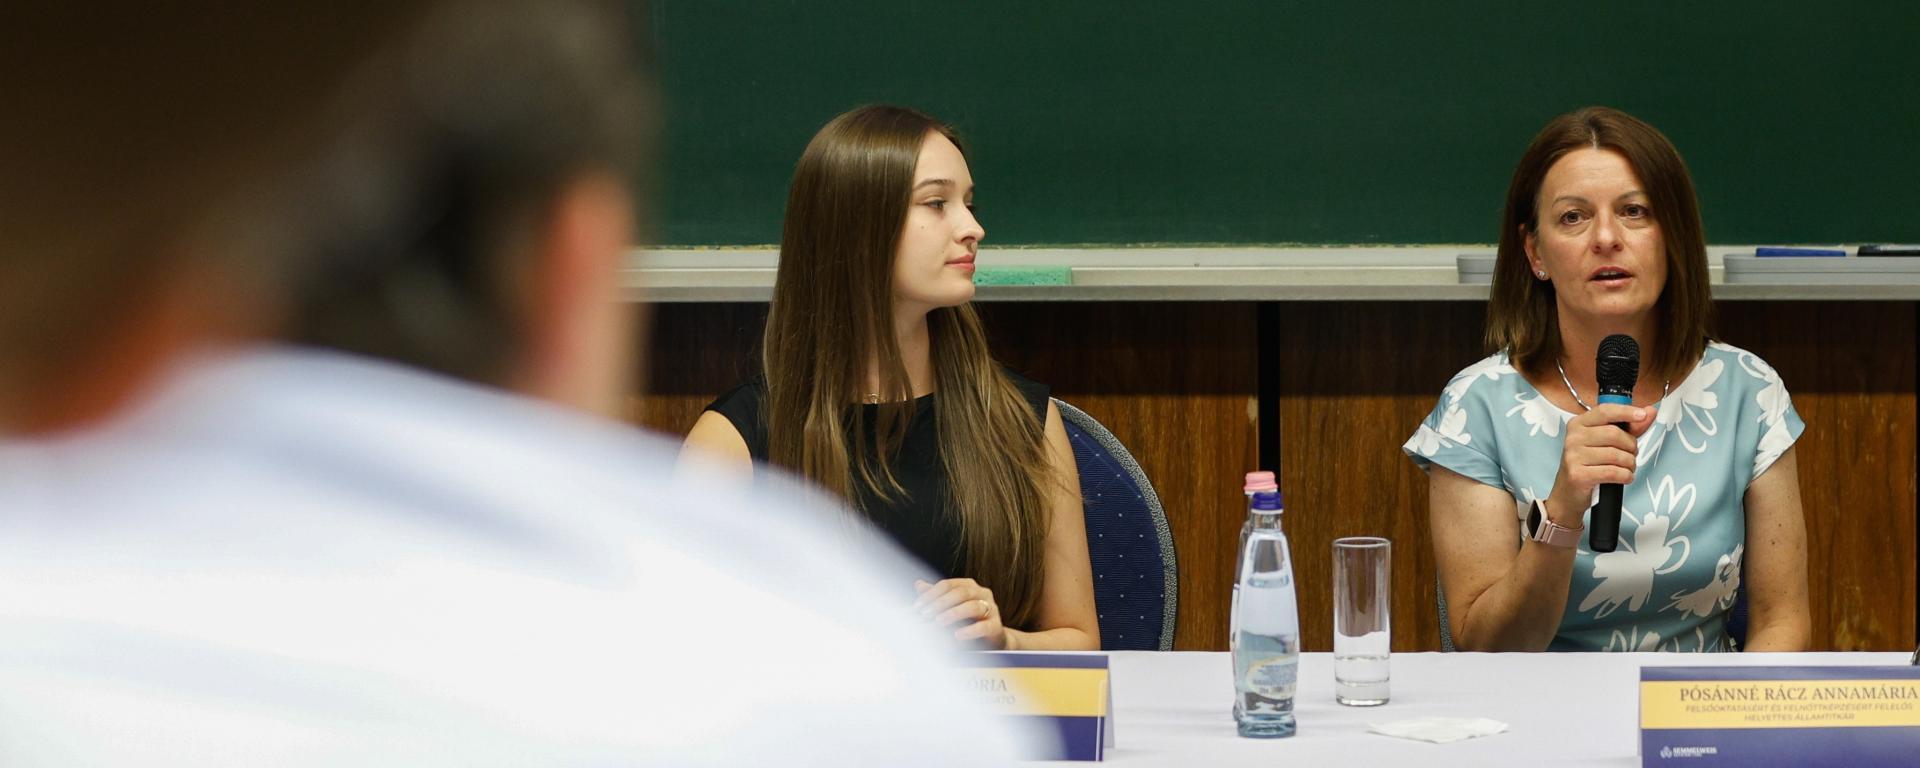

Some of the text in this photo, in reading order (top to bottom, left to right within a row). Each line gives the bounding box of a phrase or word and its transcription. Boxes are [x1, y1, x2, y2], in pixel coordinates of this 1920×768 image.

[1680, 683, 1919, 701] PÓSÁNNÉ RÁCZ ANNAMÁRIA
[1744, 713, 1792, 721] HELYETTES
